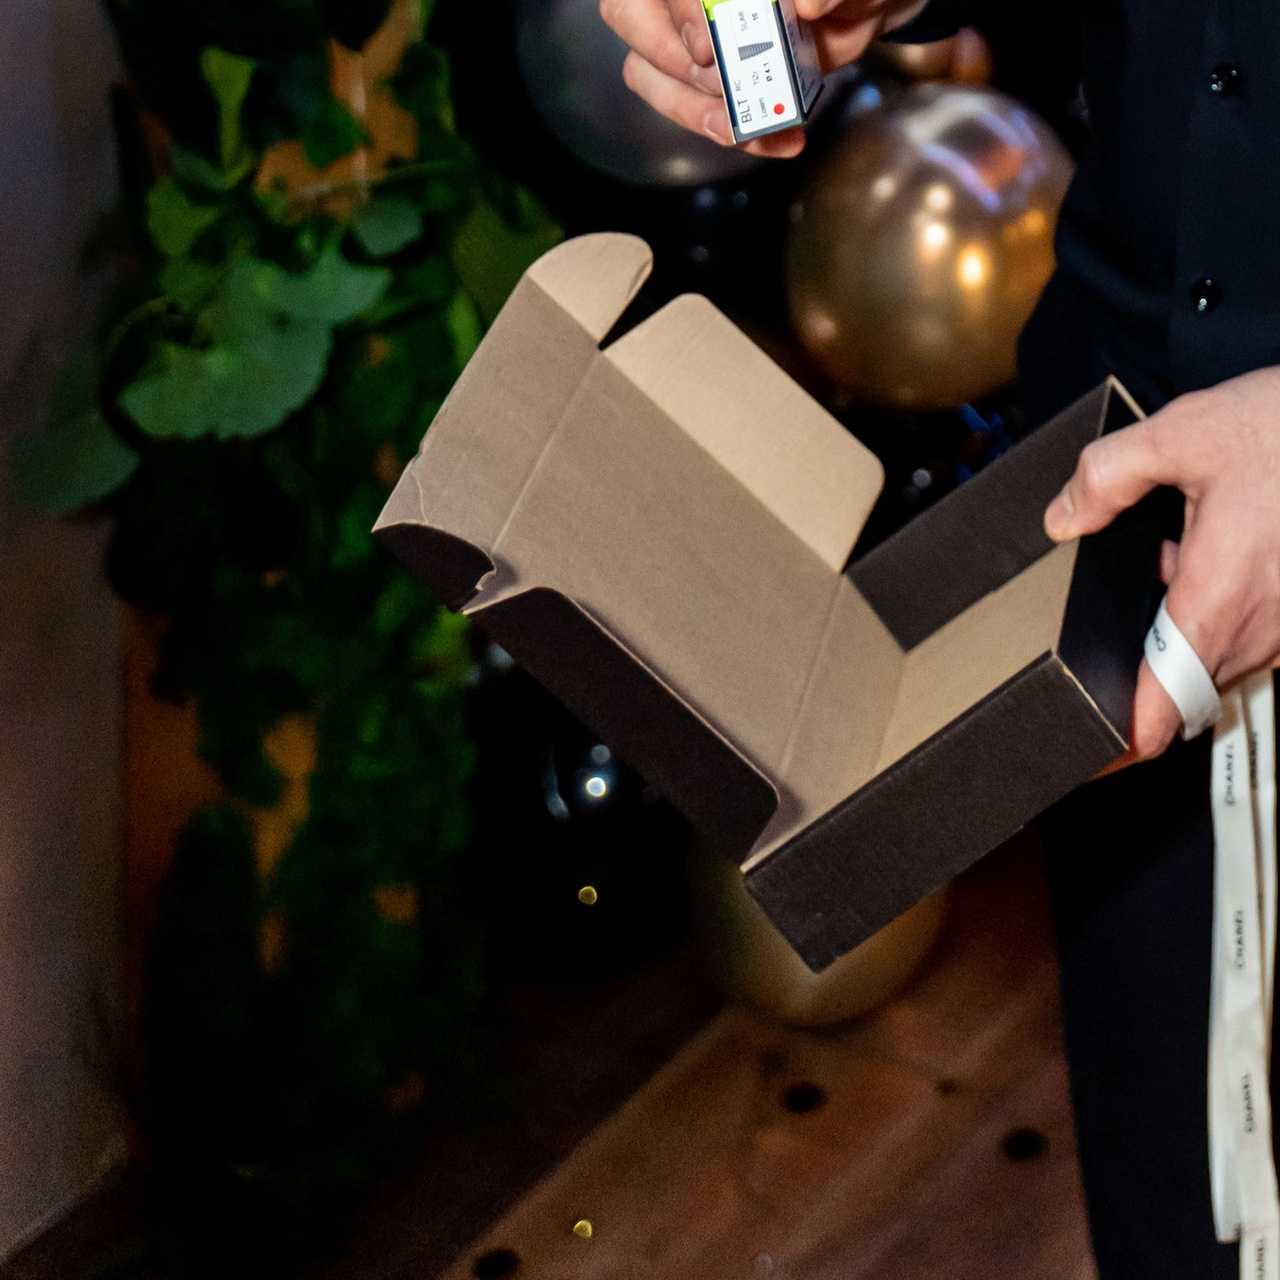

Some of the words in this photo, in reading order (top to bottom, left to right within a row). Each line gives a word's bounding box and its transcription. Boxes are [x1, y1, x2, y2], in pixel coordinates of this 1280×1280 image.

[752, 12, 759, 21] 10
[763, 62, 771, 74] 4.1
[734, 79, 742, 92] RC
[736, 98, 752, 124] BLT
[1224, 743, 1236, 807] CHANEL
[1233, 910, 1246, 971] CHANEL
[1240, 1072, 1256, 1134] CHANEL
